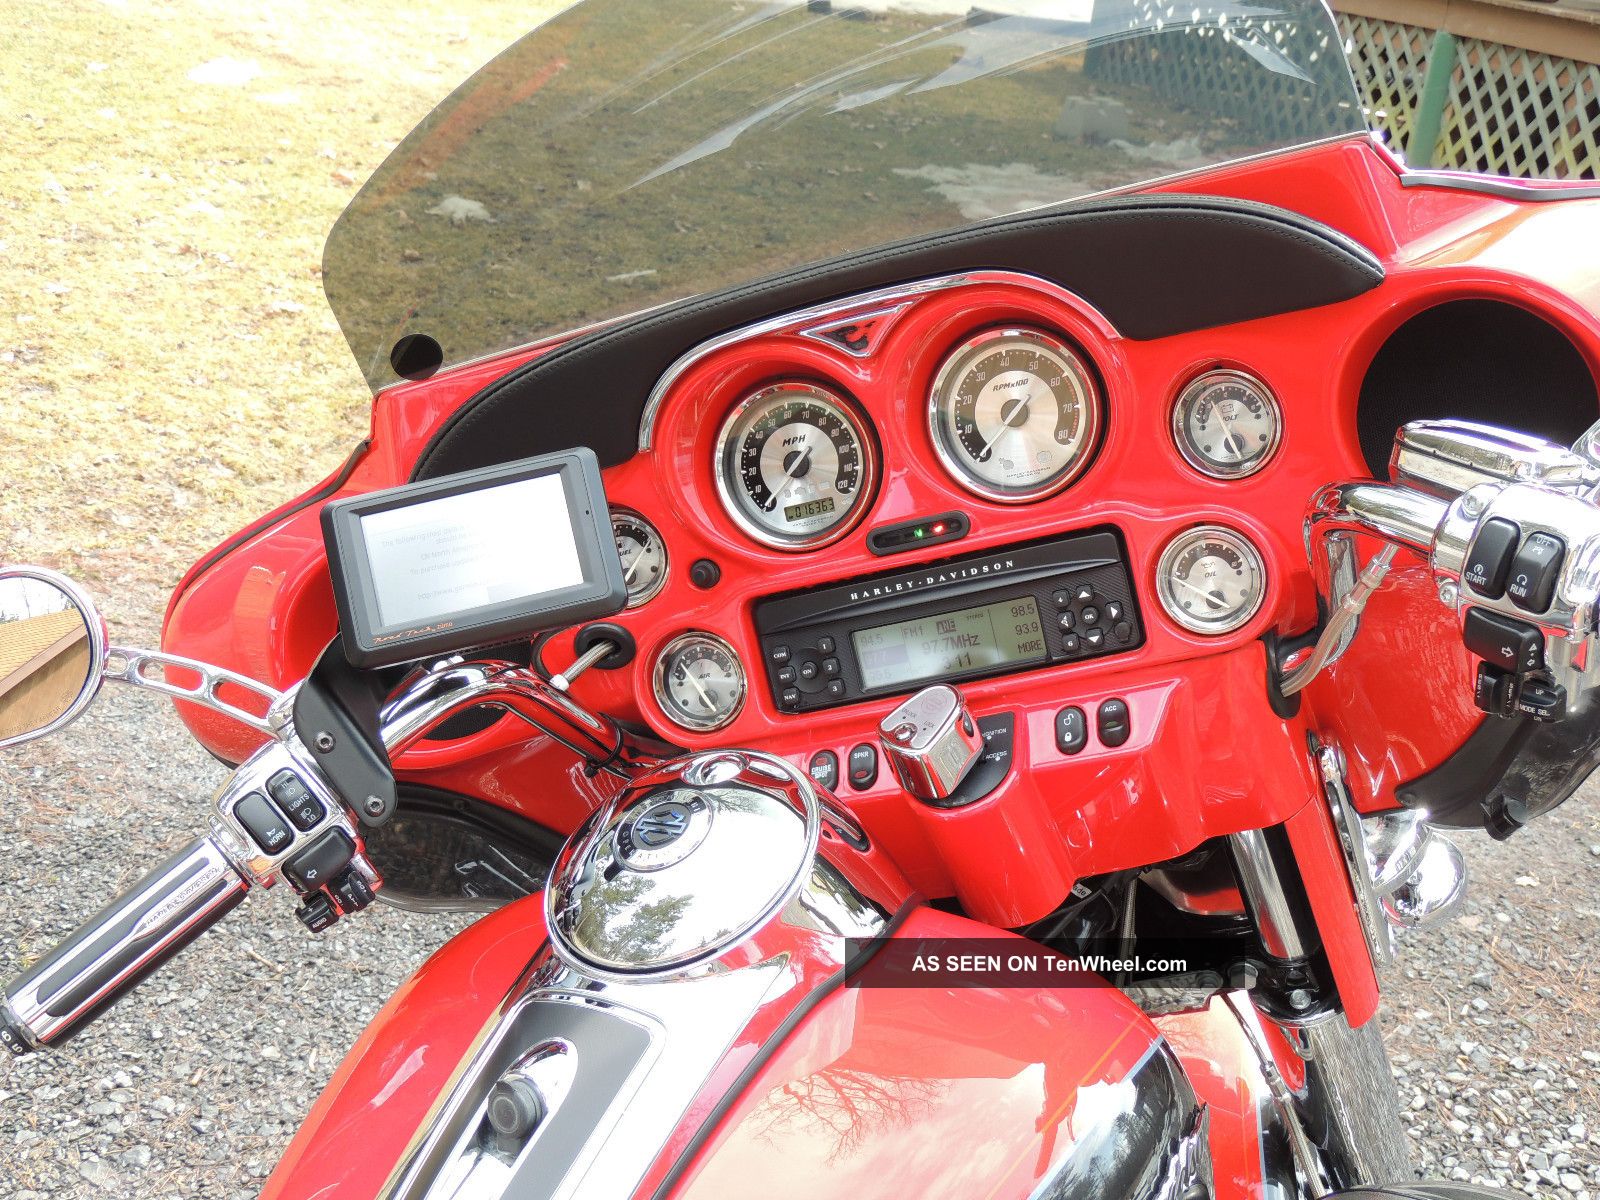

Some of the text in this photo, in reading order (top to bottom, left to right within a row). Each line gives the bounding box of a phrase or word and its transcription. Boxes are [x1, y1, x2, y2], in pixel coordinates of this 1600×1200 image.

[1029, 360, 1038, 371] 50
[976, 371, 985, 381] 30
[963, 394, 972, 405] 20
[1063, 403, 1072, 413] 70
[783, 410, 792, 420] 60
[802, 410, 810, 420] 70
[818, 416, 827, 427] 80
[782, 433, 806, 447] MPH
[749, 447, 757, 457] 30
[748, 465, 757, 476] 20
[837, 478, 849, 490] 120
[1465, 571, 1487, 586] START
[1509, 583, 1527, 598] RUN
[1010, 604, 1036, 618] 98.5
[1015, 622, 1039, 636] 93.9
[1017, 639, 1044, 655] MORE
[773, 651, 787, 659] COM
[784, 693, 797, 701] NAV
[1104, 704, 1117, 713] ACC
[1519, 703, 1536, 714] MODE
[853, 751, 869, 759] SPKR
[288, 793, 310, 812] LIGHTS
[268, 829, 286, 847] HORN
